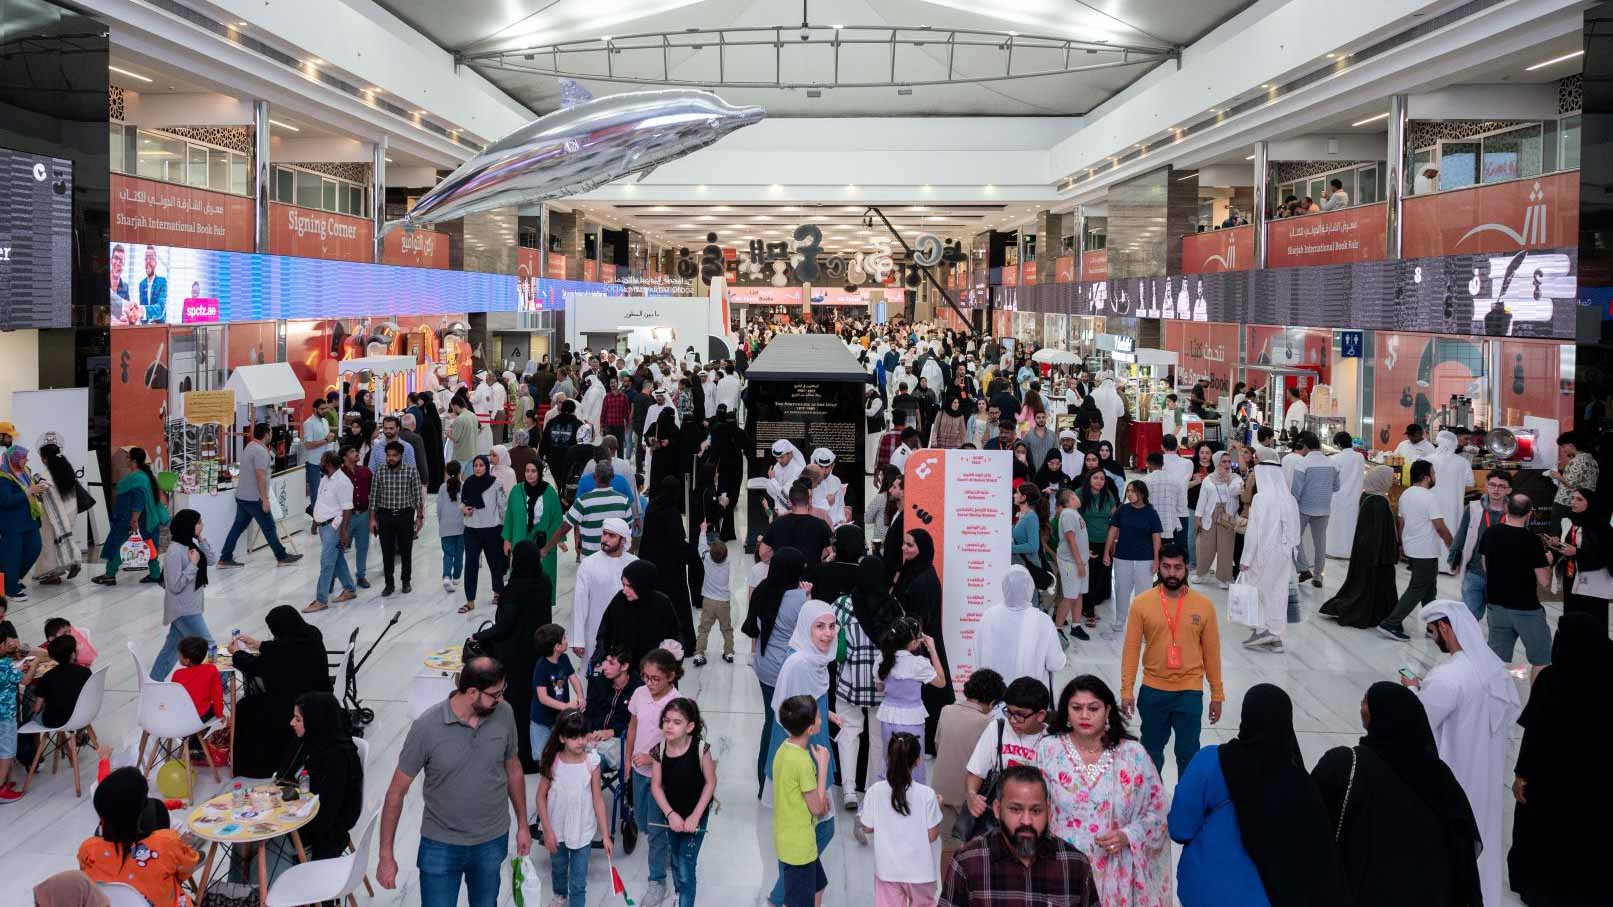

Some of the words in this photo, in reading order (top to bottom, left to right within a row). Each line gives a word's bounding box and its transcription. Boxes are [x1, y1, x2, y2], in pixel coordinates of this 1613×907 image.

[116, 213, 147, 229] Sharjah
[148, 217, 195, 233] International
[197, 223, 213, 235] Book
[213, 225, 225, 236] Fair
[288, 209, 327, 240] Signing
[328, 218, 356, 239] Corner
[1288, 245, 1303, 256] Sharjah
[1304, 242, 1334, 253] International
